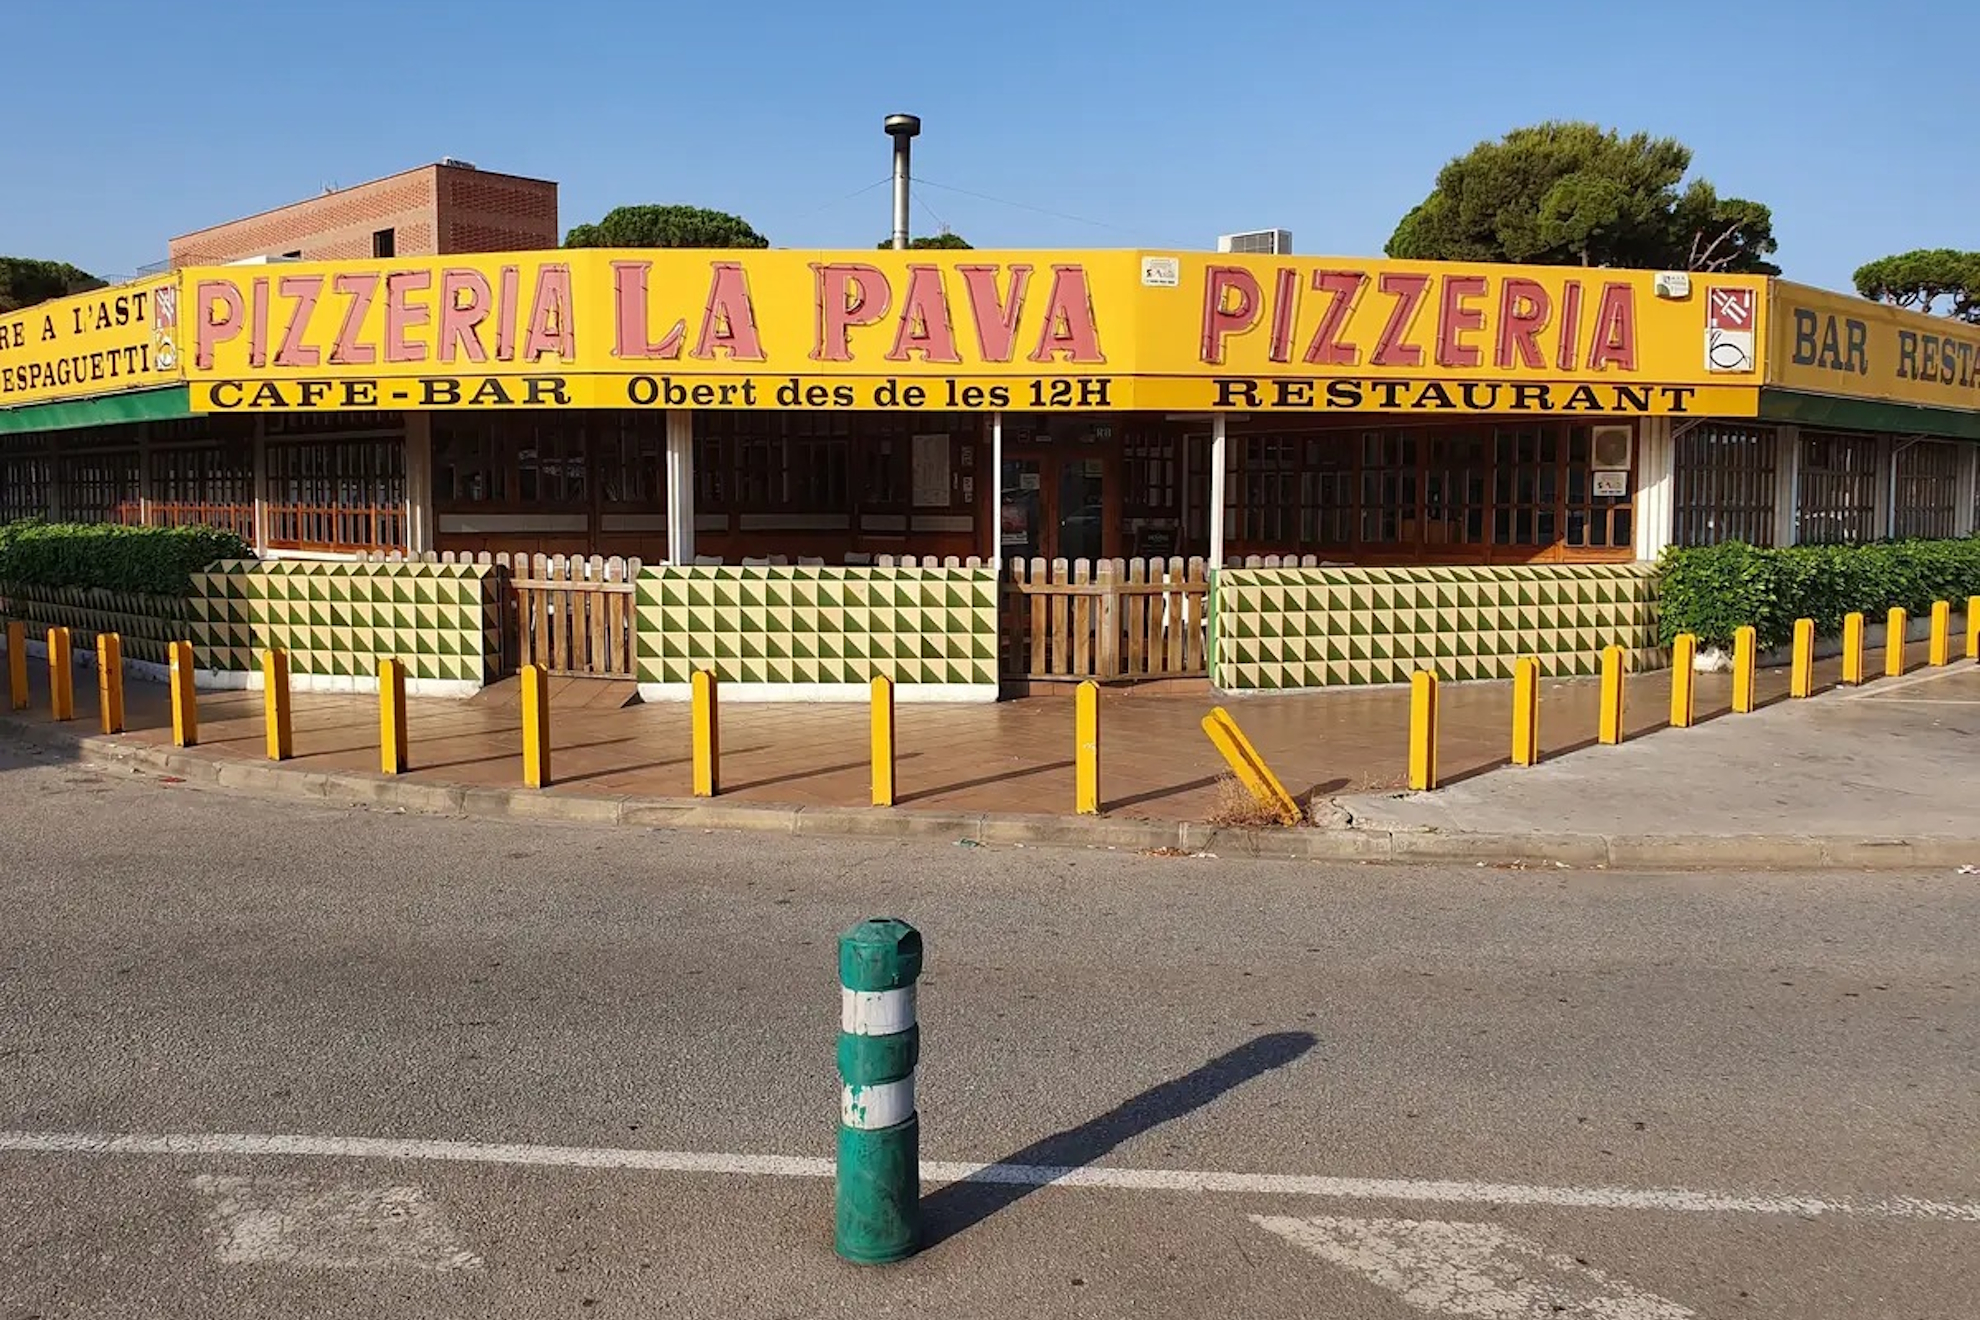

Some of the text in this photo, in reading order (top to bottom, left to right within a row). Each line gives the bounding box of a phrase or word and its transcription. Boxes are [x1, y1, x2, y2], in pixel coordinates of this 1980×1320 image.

[41, 315, 56, 341] A
[195, 260, 1107, 369] PIZZERIA LA PAVA
[1200, 265, 1639, 371] PIZZERIA
[1792, 307, 1868, 376] BAR
[2, 344, 150, 393] ESPAGUETTI
[628, 376, 1111, 407] Obert des de les 12H
[1212, 379, 1696, 412] RESTAURANT
